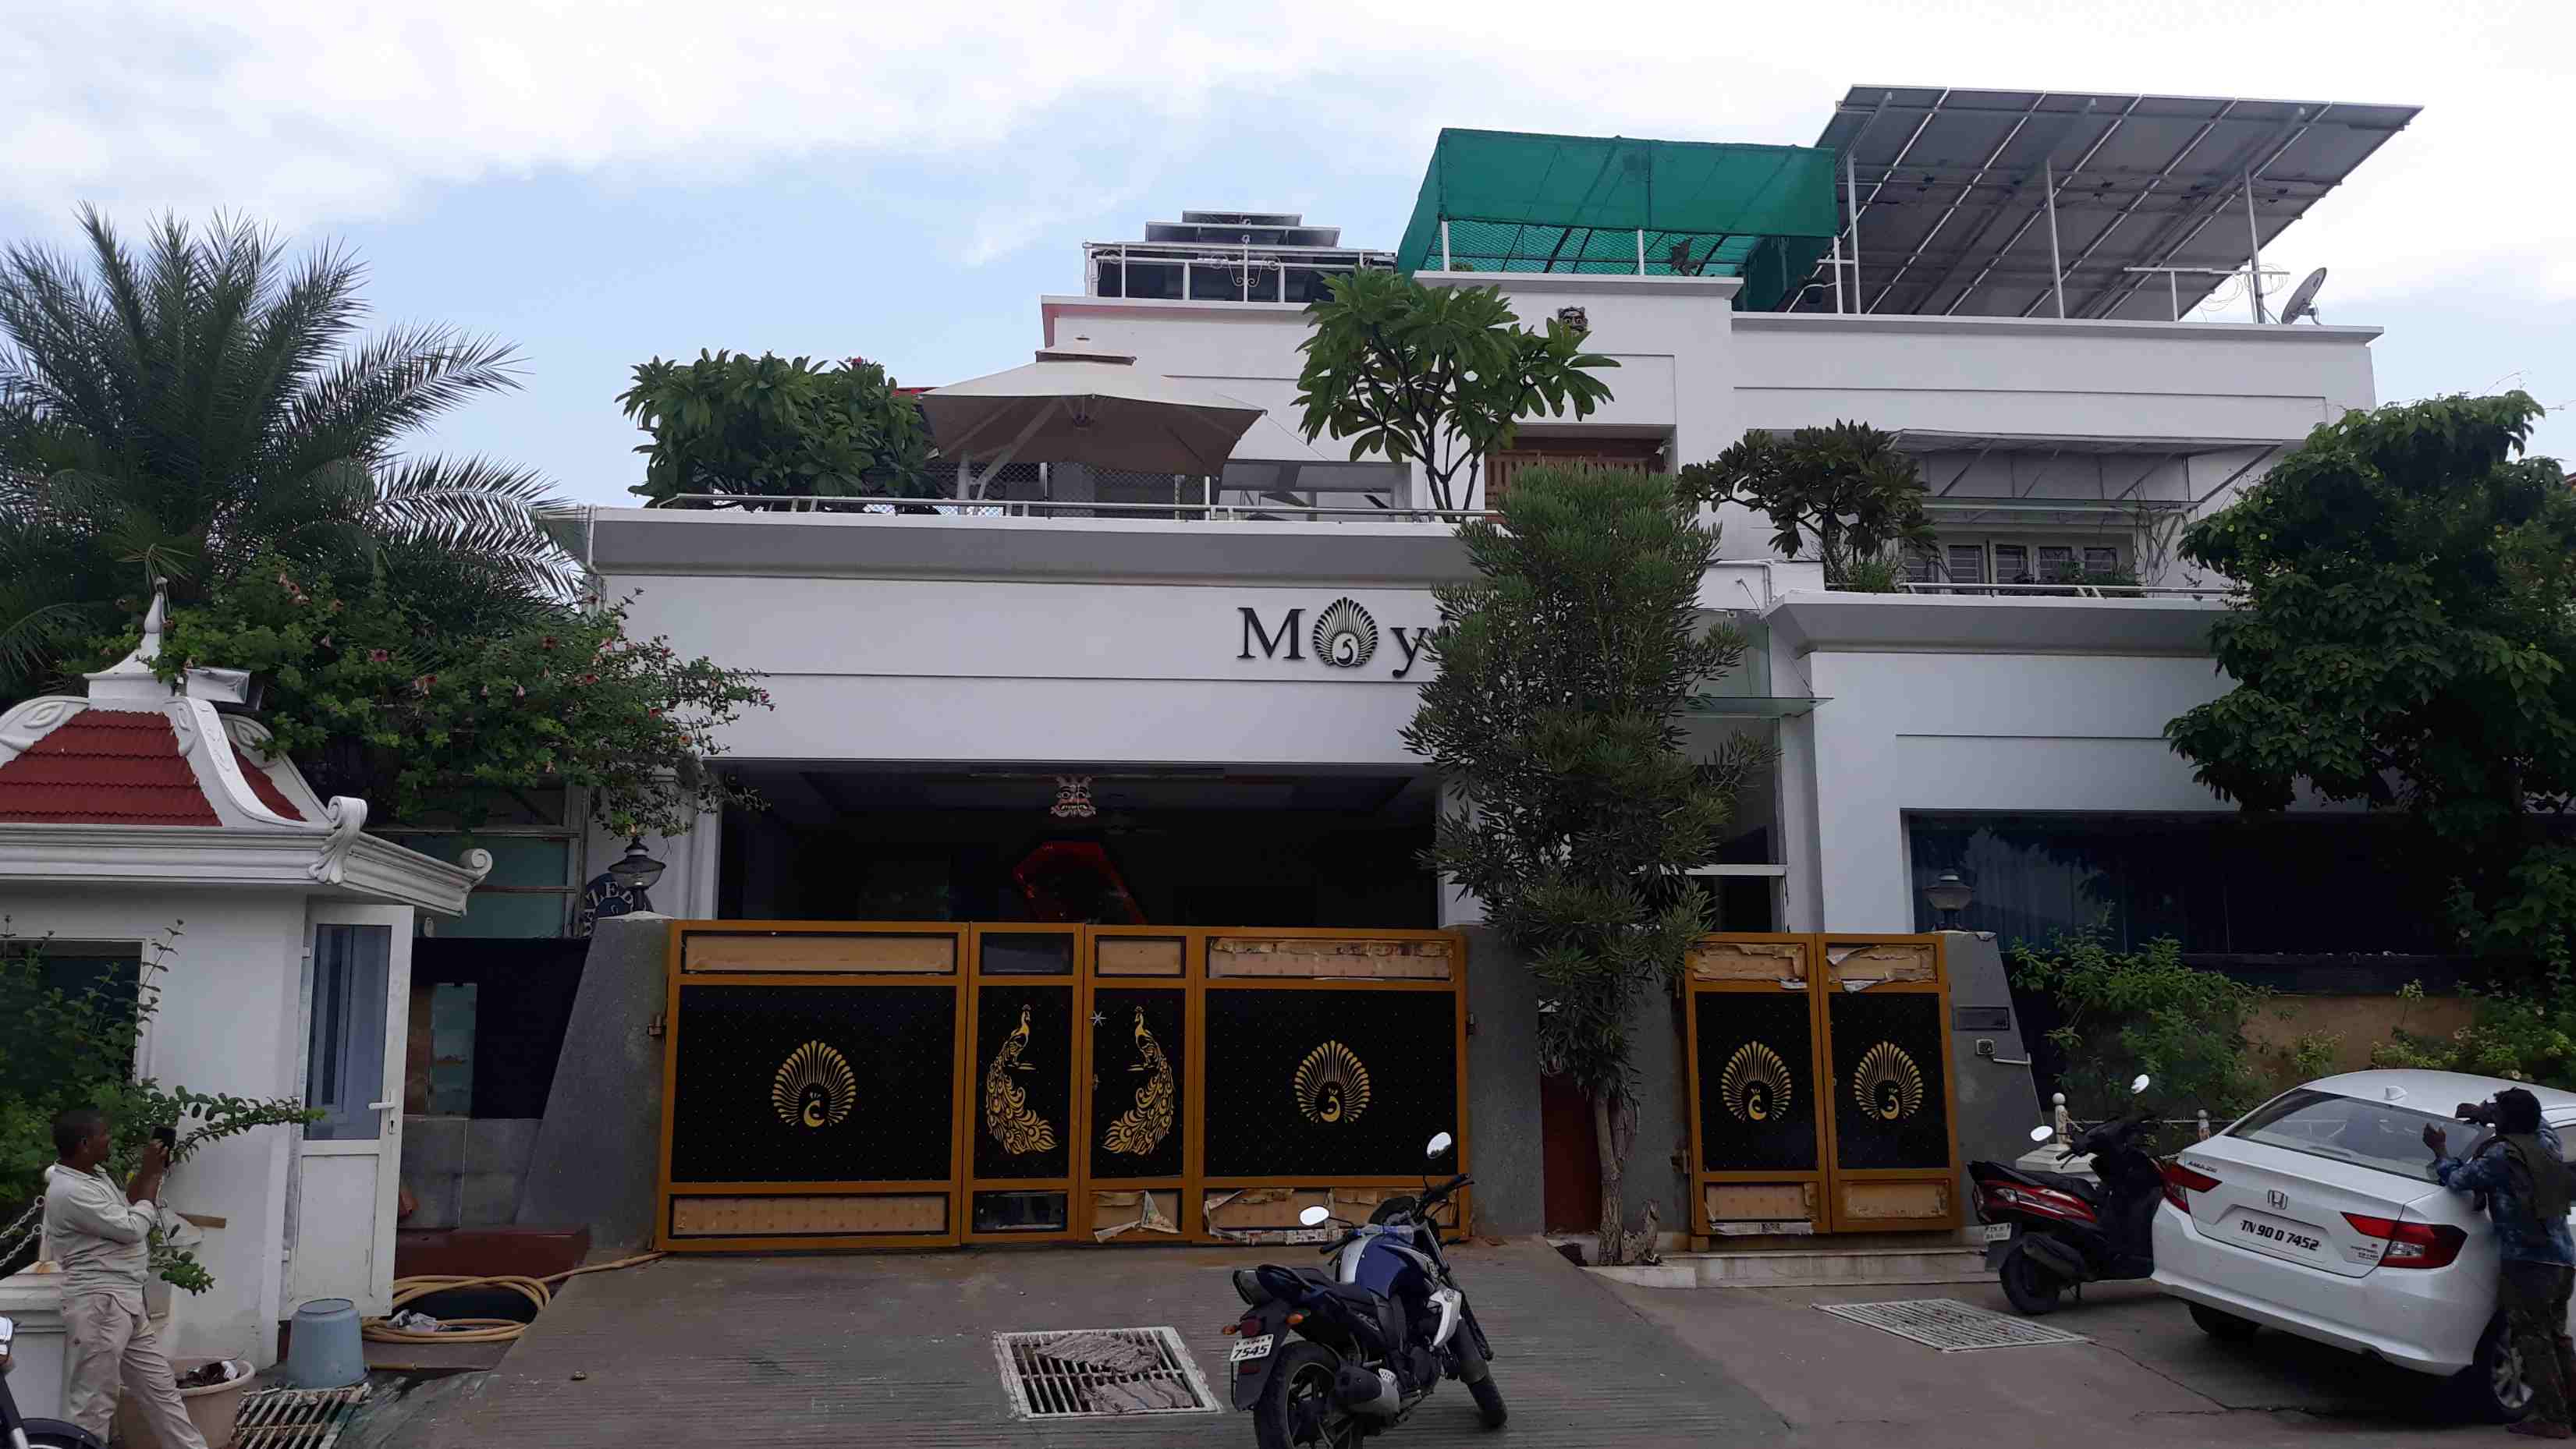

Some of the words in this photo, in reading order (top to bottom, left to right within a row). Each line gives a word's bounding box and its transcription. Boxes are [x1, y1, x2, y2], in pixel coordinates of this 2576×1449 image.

[2241, 1220, 2256, 1233] TN
[2256, 1225, 2274, 1238] 90
[2287, 1232, 2319, 1251] 7452
[1233, 1344, 1270, 1359] 7545
